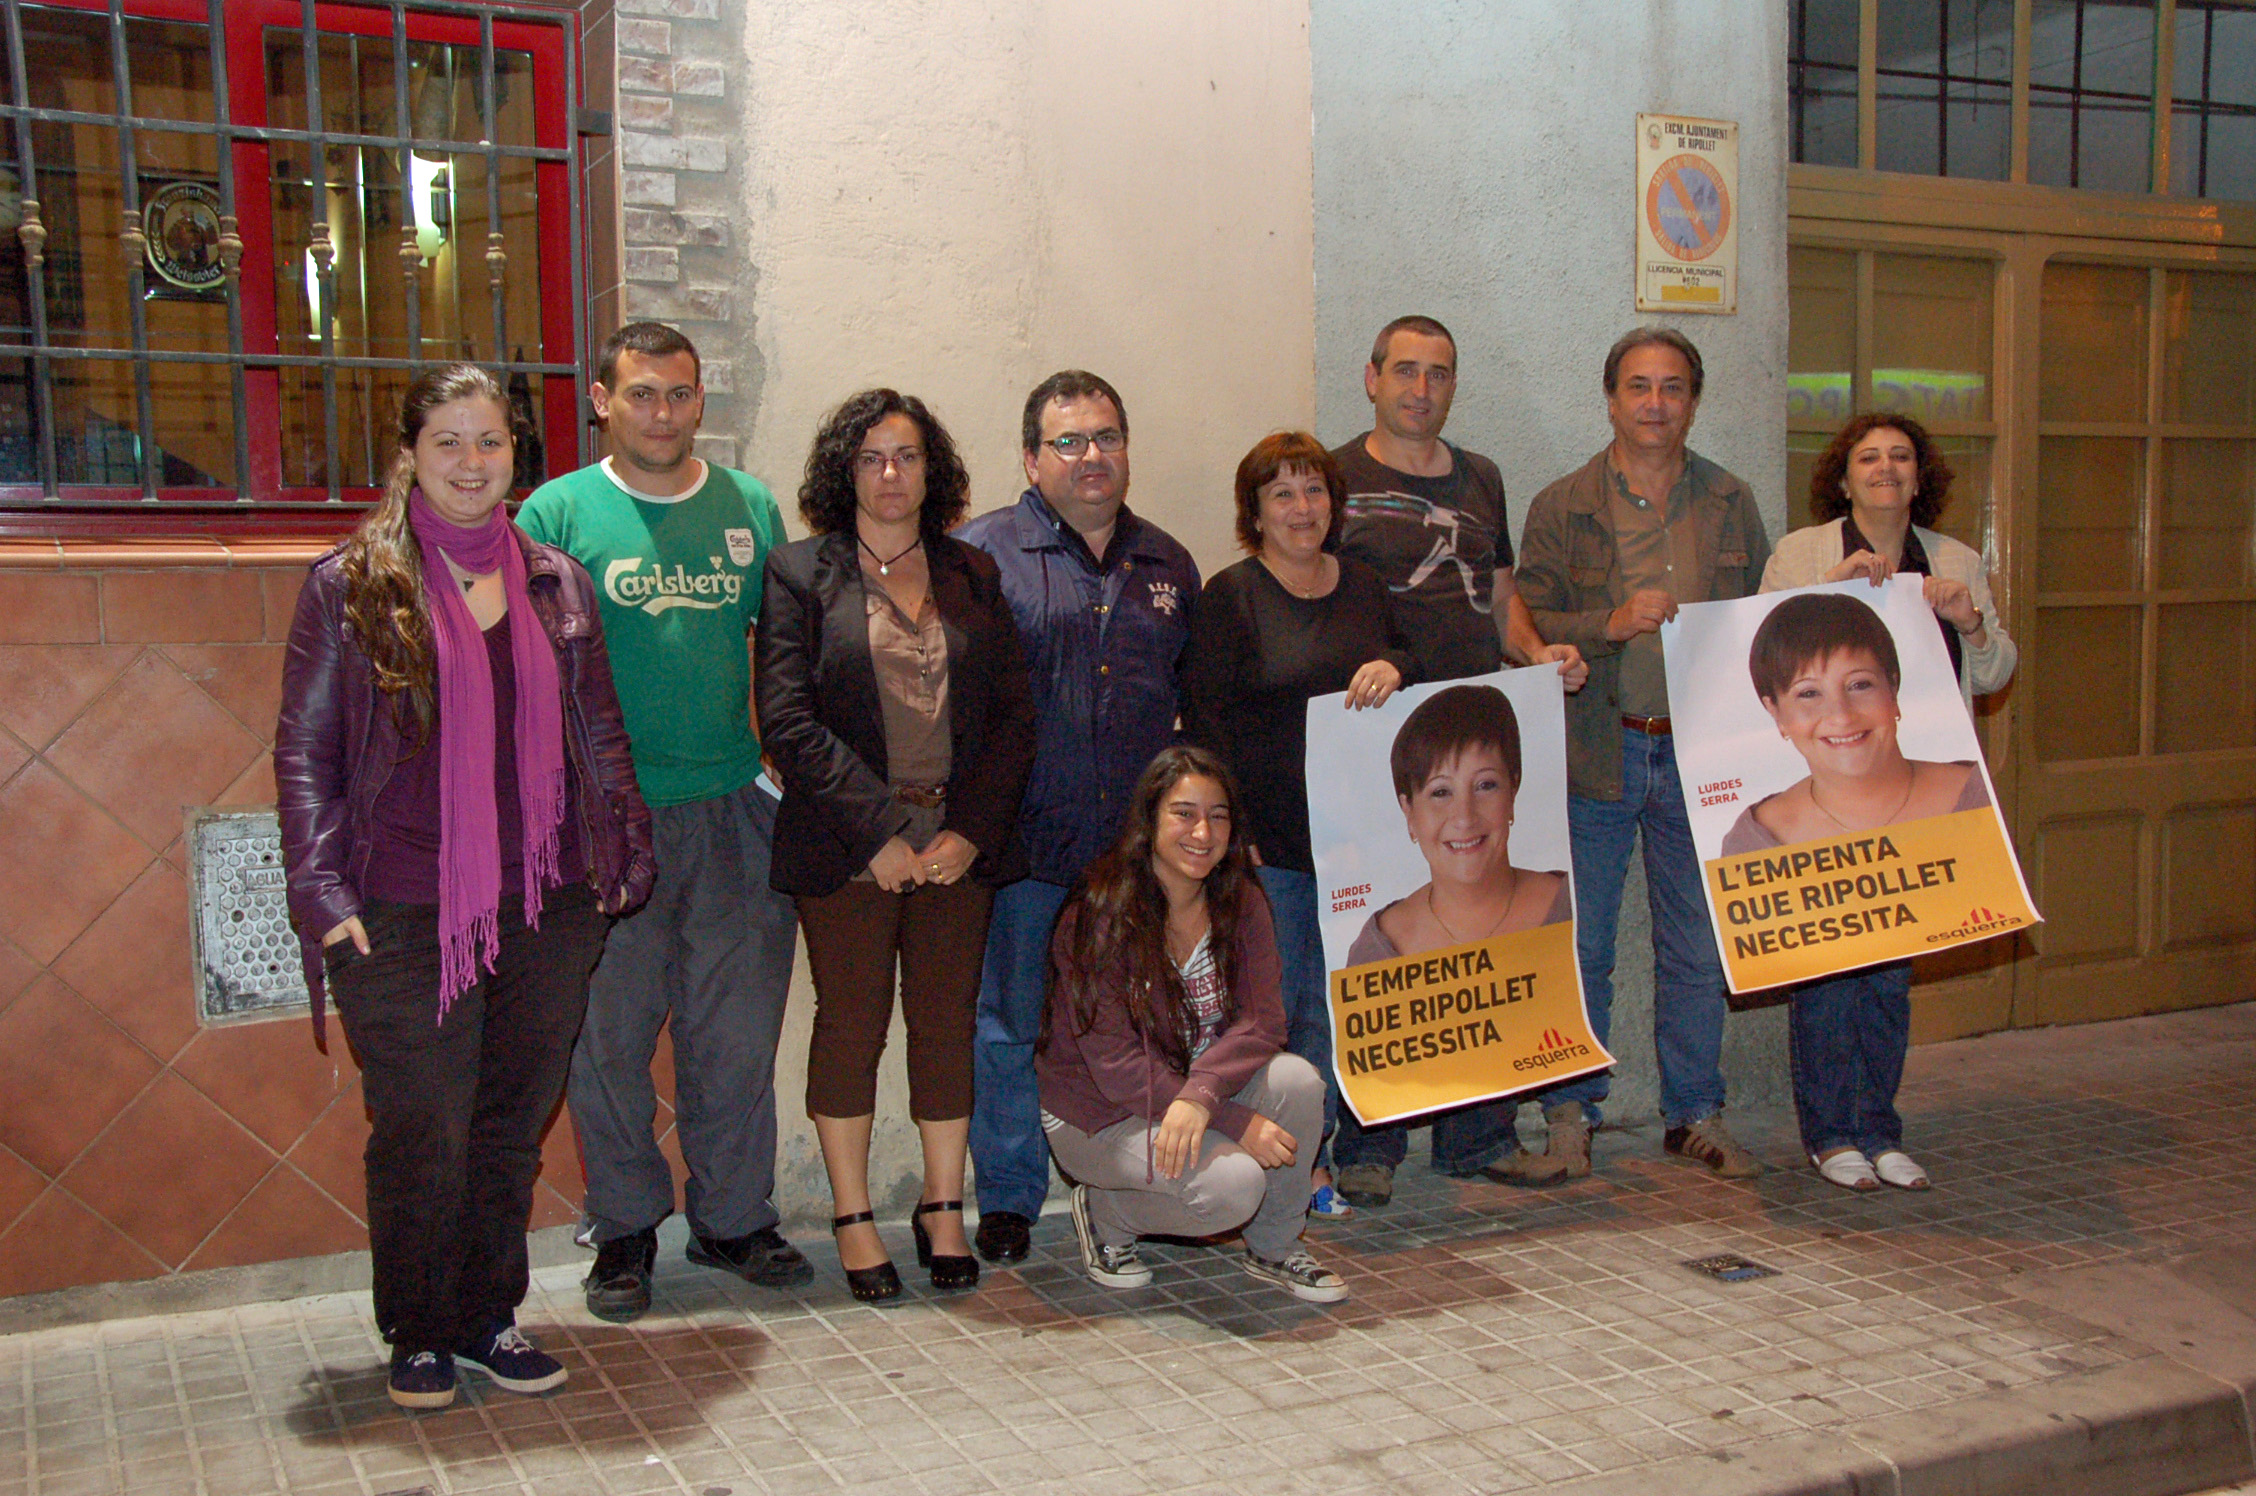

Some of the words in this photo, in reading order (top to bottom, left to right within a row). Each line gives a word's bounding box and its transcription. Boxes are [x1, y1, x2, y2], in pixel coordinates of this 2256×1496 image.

[1678, 137, 1686, 149] DE
[1688, 138, 1716, 151] RIPOLLET
[1686, 124, 1727, 140] AJUNTAMENT
[1685, 267, 1723, 277] MUNICIPAL
[604, 556, 741, 609] Carlsberg
[1697, 778, 1743, 795] LURDES
[1700, 792, 1739, 807] SERRA
[1717, 835, 1901, 892] L'EMPENTA
[248, 871, 285, 887] AGUA
[1331, 883, 1372, 900] LURDES
[1726, 890, 1794, 925] QUE
[1800, 857, 1957, 912] RIPOLLET
[1331, 897, 1367, 913] SERRA
[1734, 903, 1919, 960] NECESSITA
[1926, 915, 2023, 944] esquerra
[1340, 948, 1495, 1003] L'EMPENTA
[1345, 1003, 1402, 1039] QUE
[1409, 973, 1537, 1025] RIPOLLET
[1346, 1018, 1503, 1076] NECESSITA
[1513, 1041, 1590, 1072] esquerra
